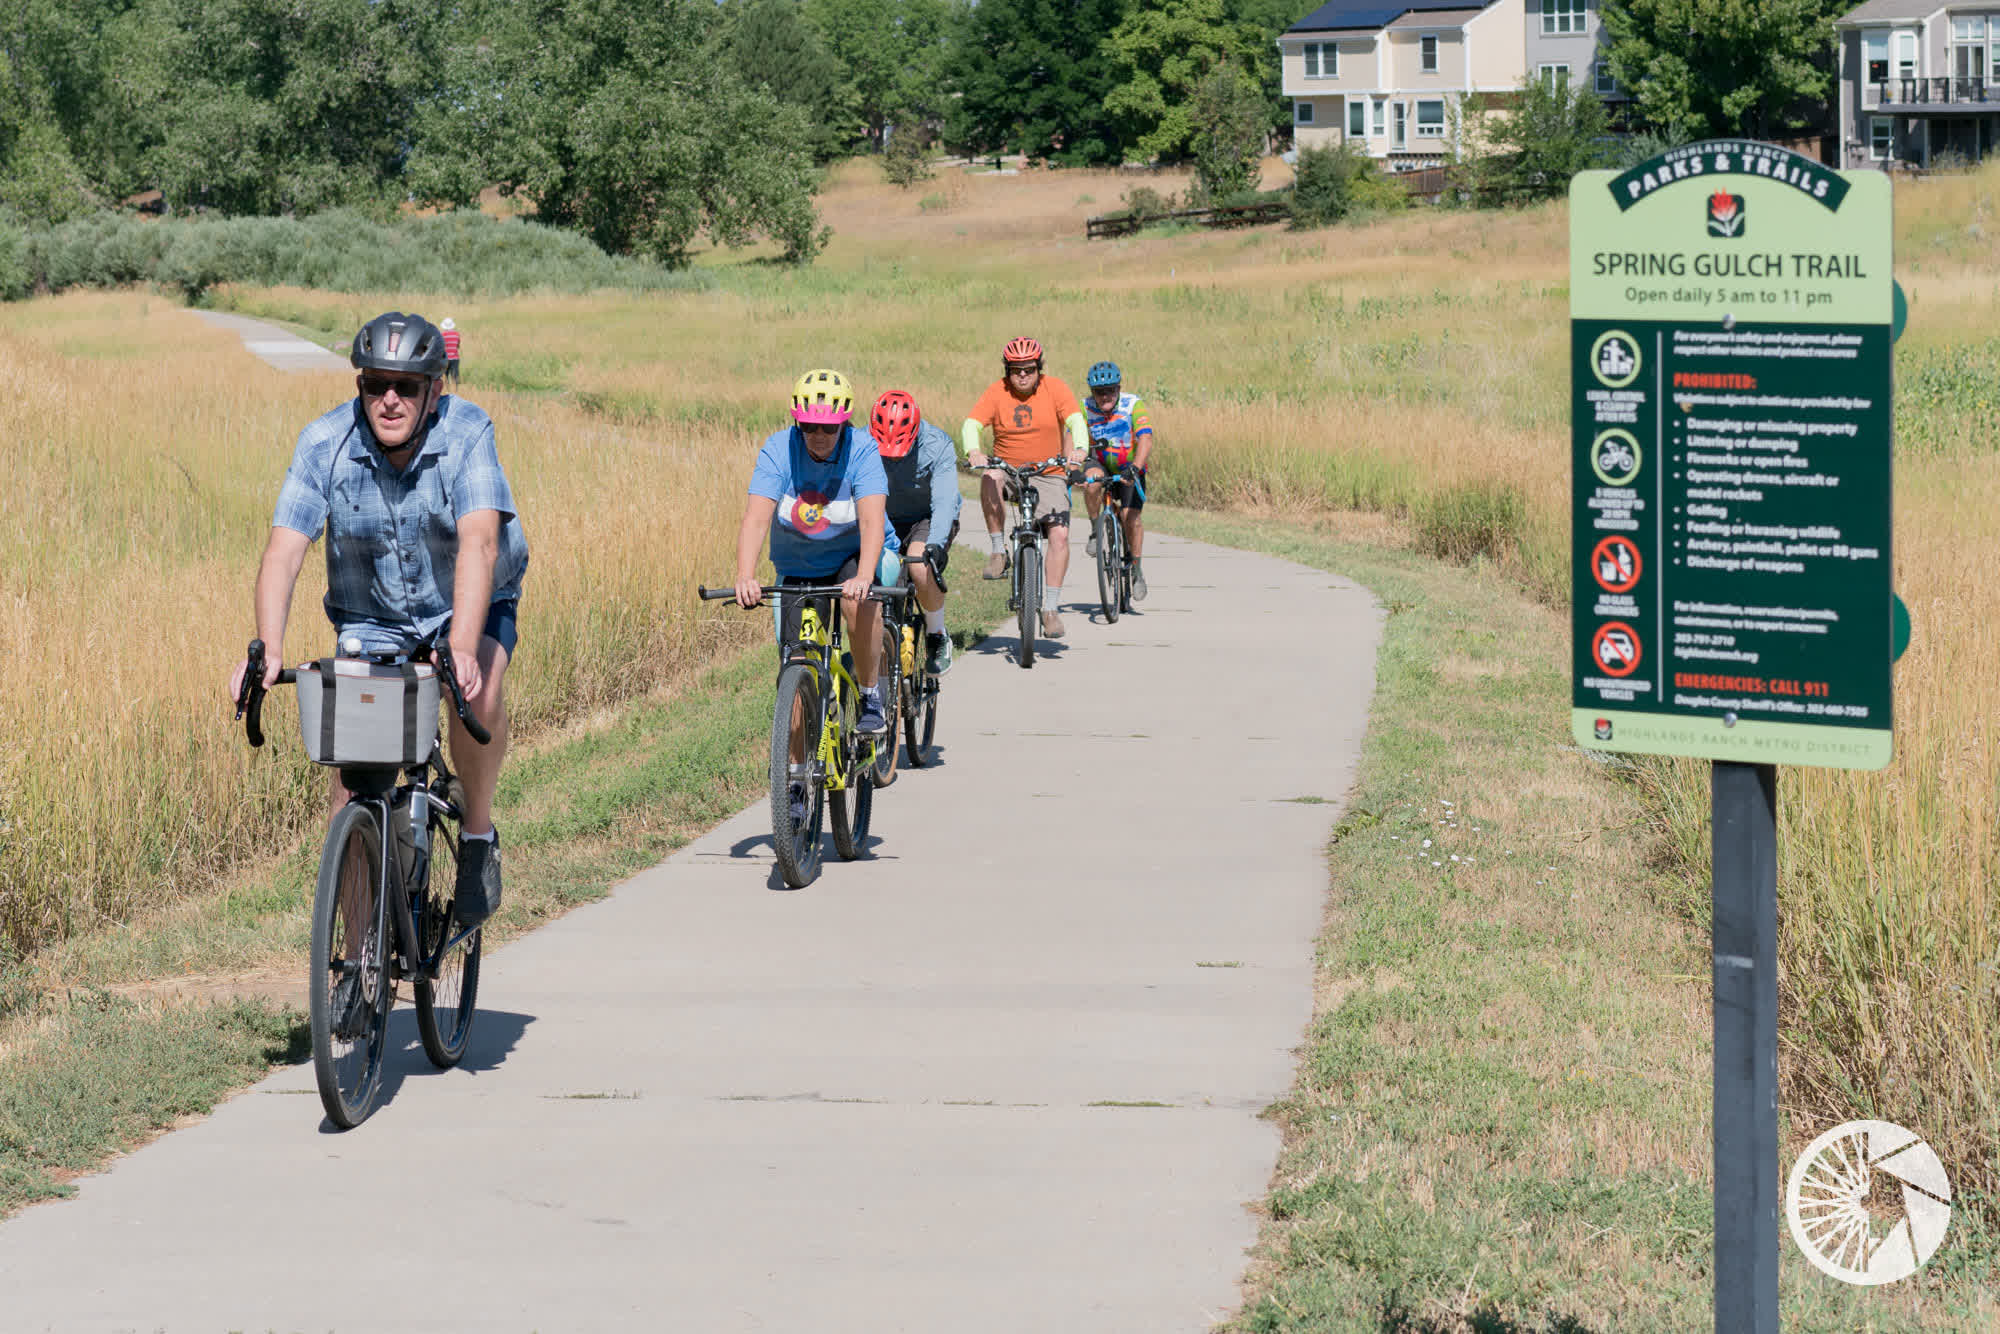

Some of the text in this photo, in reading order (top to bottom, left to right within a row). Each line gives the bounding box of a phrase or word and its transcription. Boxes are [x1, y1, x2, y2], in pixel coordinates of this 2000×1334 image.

[1664, 143, 1740, 163] HIGHLANDS
[1627, 153, 1830, 198] PARKS & TRAILS
[1593, 252, 1867, 279] SPRING GULCH TRAIL
[1625, 287, 1832, 307] Open daily 5 am to 11 pm
[1673, 372, 1756, 389] PROHIBITED:
[1686, 417, 1857, 436] Damaging or misusing property
[1686, 435, 1798, 452] Littering or dumping
[1686, 452, 1808, 468] Fireworks or open fires
[1686, 469, 1839, 486] Operating drones, aircraft or
[1686, 503, 1728, 519] Golfing
[1686, 520, 1840, 539] Feeding or harassing wildlife
[1687, 538, 1731, 553] Archery,
[1733, 540, 1783, 555] paintball,
[1785, 543, 1817, 556] pellet
[1819, 546, 1831, 556] or
[1850, 547, 1878, 560] guns
[1686, 555, 1804, 573] Discharge of weapons
[1733, 620, 1742, 628] or
[1674, 672, 1828, 696] EMERGENCIES: CALL 911
[1617, 728, 1873, 756] HIGHLANDS RANCH METRO DISTRICT
